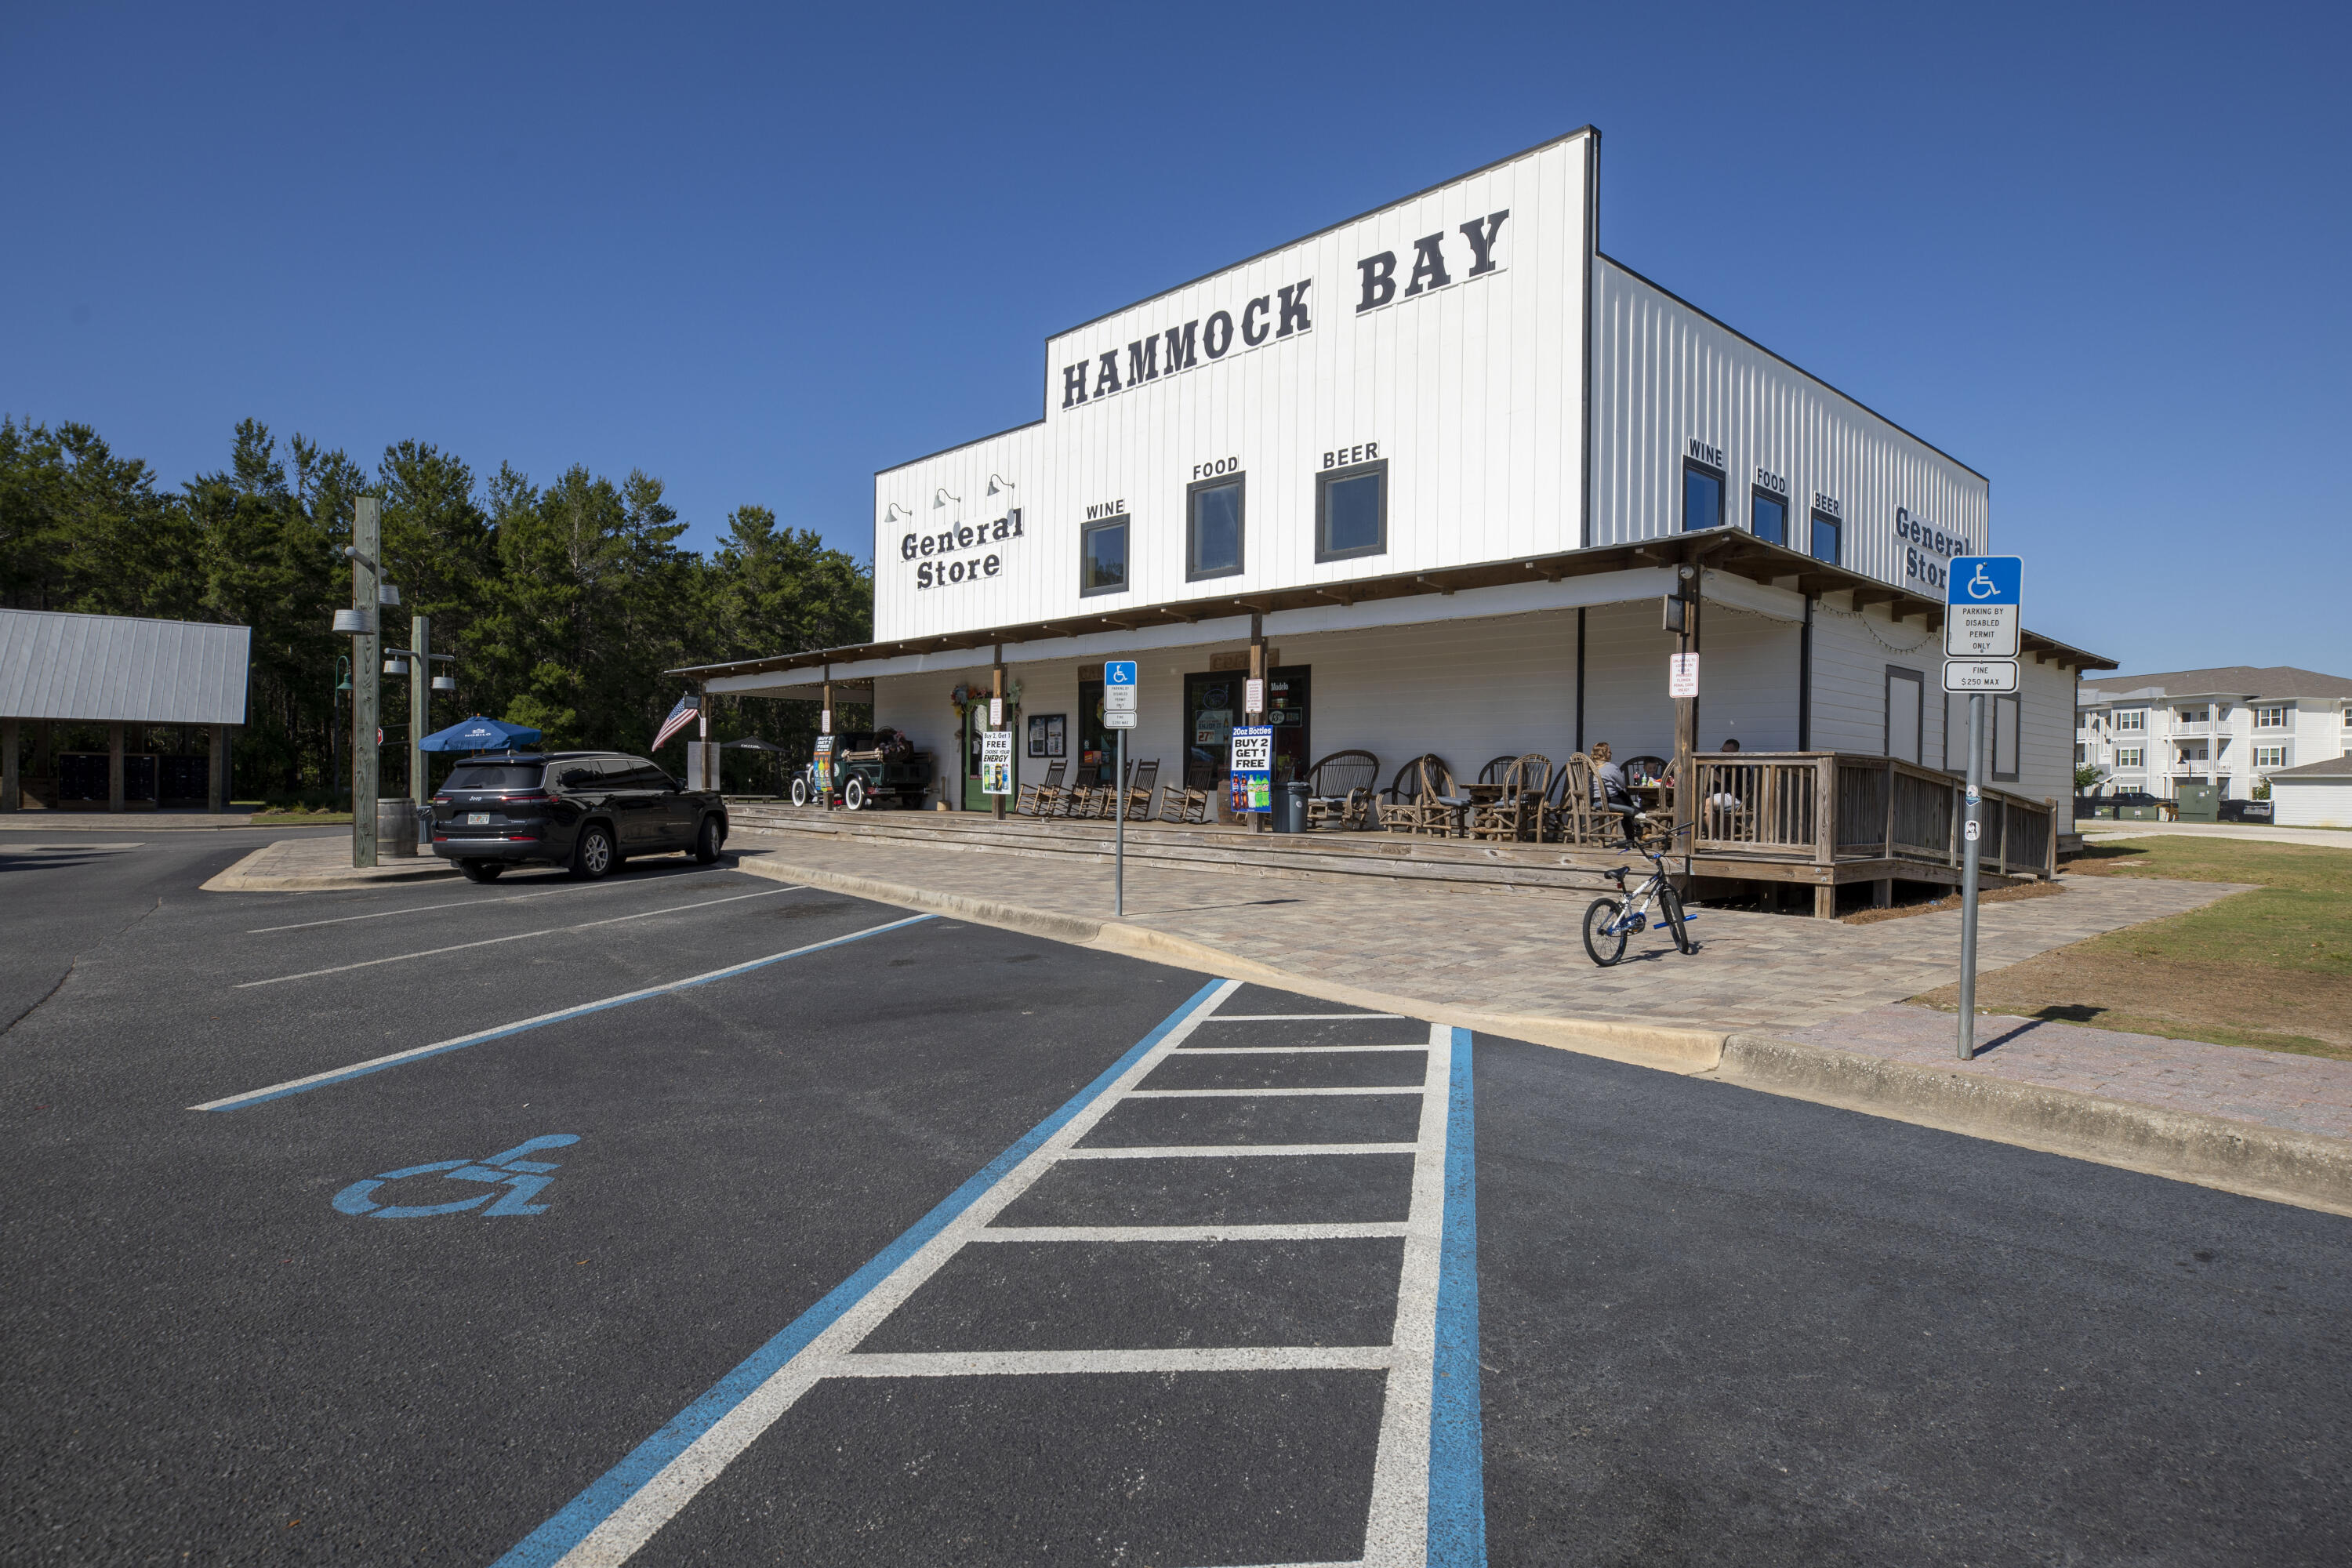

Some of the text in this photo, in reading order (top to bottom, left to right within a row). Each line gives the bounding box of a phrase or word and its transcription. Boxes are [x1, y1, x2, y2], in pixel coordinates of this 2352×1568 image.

[1062, 209, 1510, 409] HAMMOCK BAY
[1323, 441, 1378, 470] BEER
[1689, 437, 1722, 467] WINE
[1192, 456, 1239, 480] FOOD
[1757, 466, 1786, 493] FOOD
[1087, 499, 1125, 520] WINE
[1814, 491, 1839, 516] BEER
[901, 507, 1023, 561] General
[1896, 506, 1969, 557] General
[917, 554, 1000, 590] Store
[1906, 546, 1946, 589] Stor
[1271, 681, 1289, 690] Modelo
[1961, 677, 2000, 686] $250 MAX
[1248, 726, 1272, 735] Bottles
[986, 740, 1007, 749] FREE
[1235, 738, 1269, 748] BUY 2
[1236, 749, 1266, 757] GET 1
[983, 754, 1009, 763] ENERGY
[1236, 759, 1265, 768] FREE
